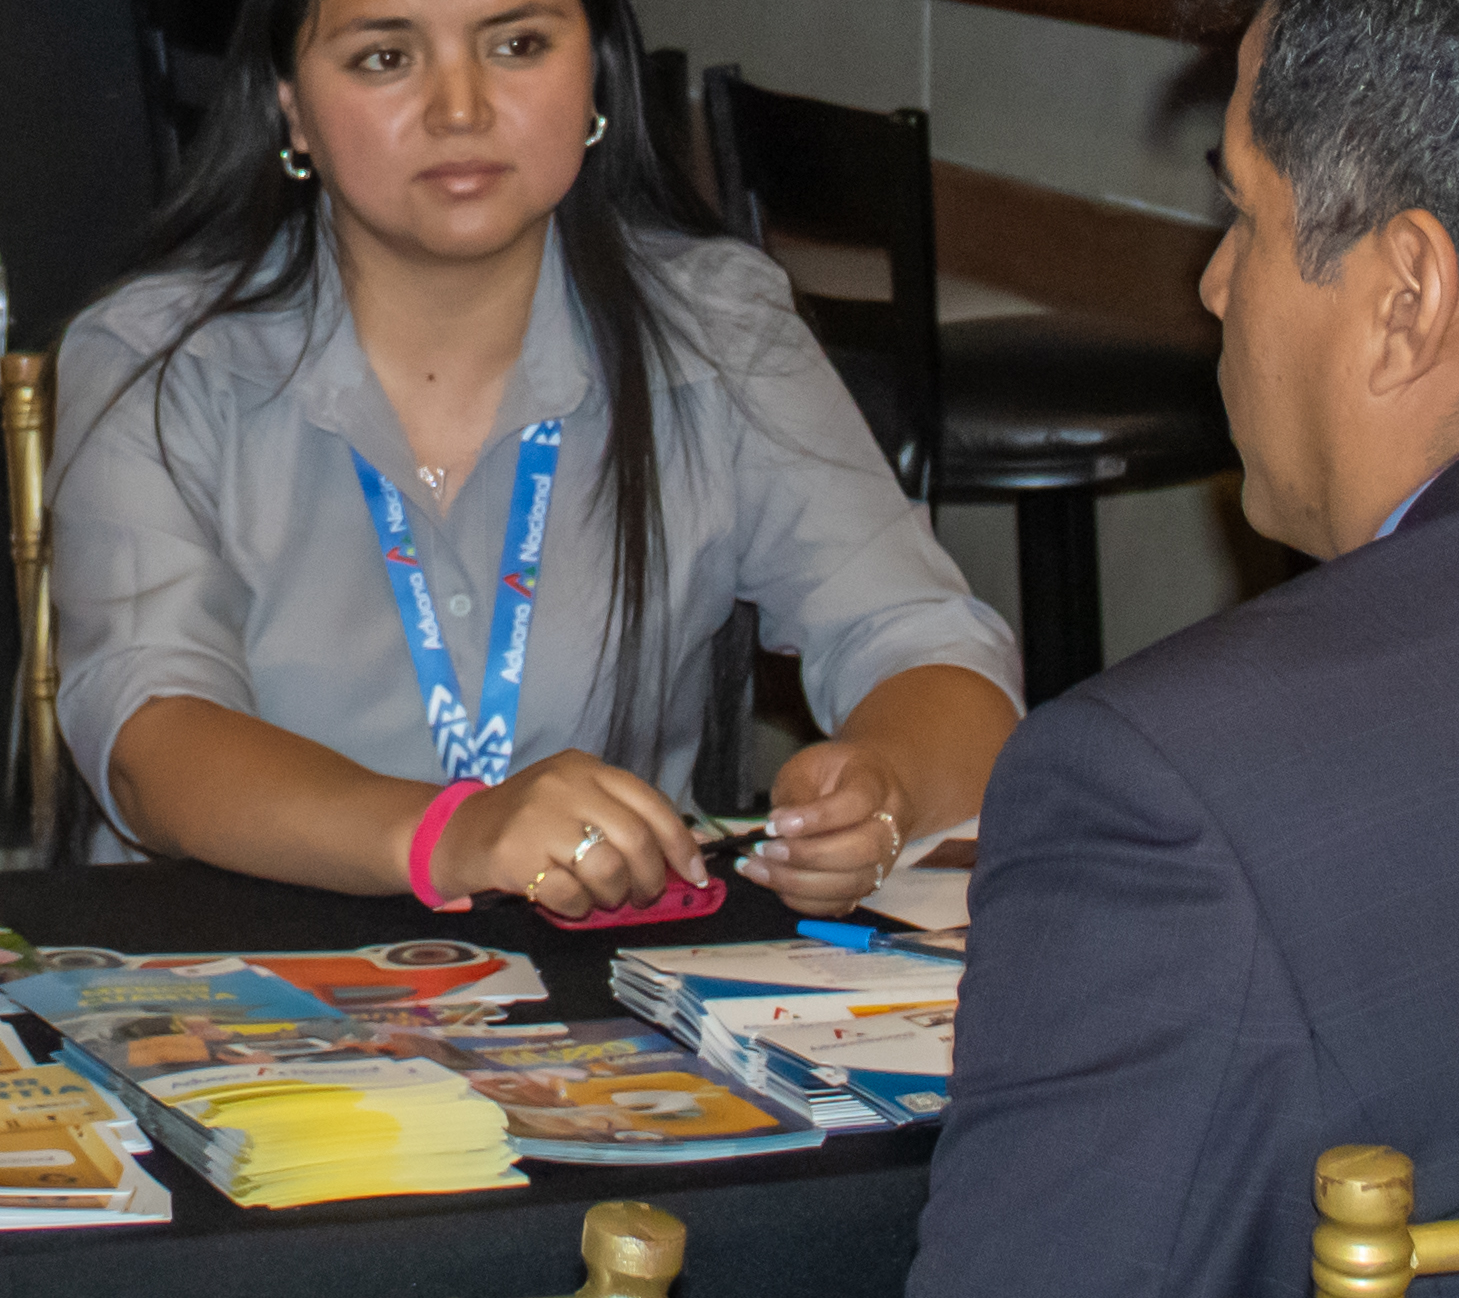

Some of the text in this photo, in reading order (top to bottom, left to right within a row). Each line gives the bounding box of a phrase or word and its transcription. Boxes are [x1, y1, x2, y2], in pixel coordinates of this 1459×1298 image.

[409, 571, 443, 649] Aduana
[500, 473, 552, 684] Aduana Nacional
